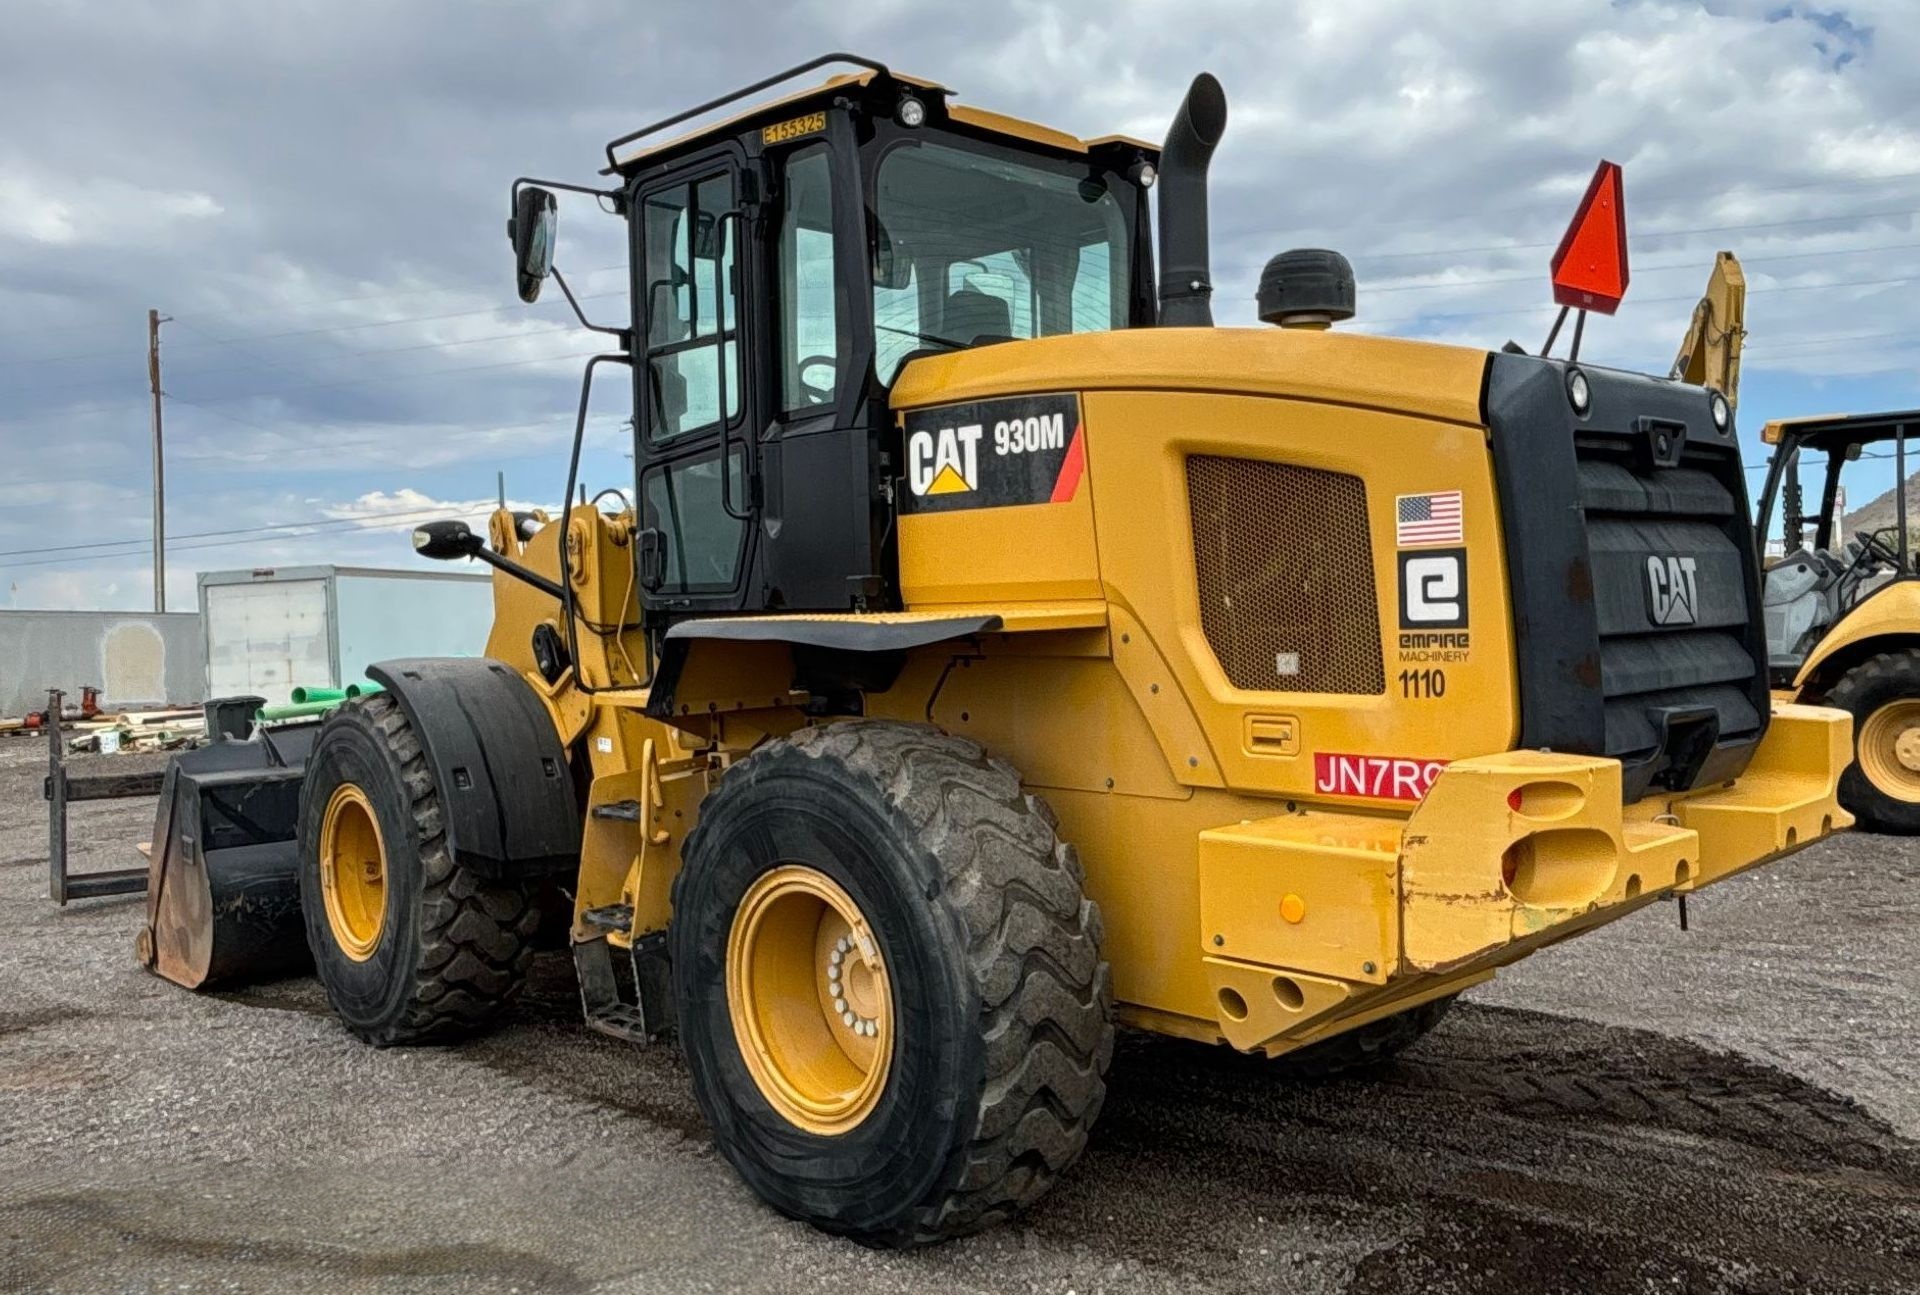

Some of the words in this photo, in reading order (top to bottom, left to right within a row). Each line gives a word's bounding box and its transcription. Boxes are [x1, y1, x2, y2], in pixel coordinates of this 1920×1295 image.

[764, 115, 824, 142] E155325
[909, 424, 983, 496] CAT
[994, 413, 1064, 456] 930M
[1647, 555, 1698, 624] CAT
[1399, 651, 1469, 662] MACHINERY
[1399, 668, 1445, 698] 1110
